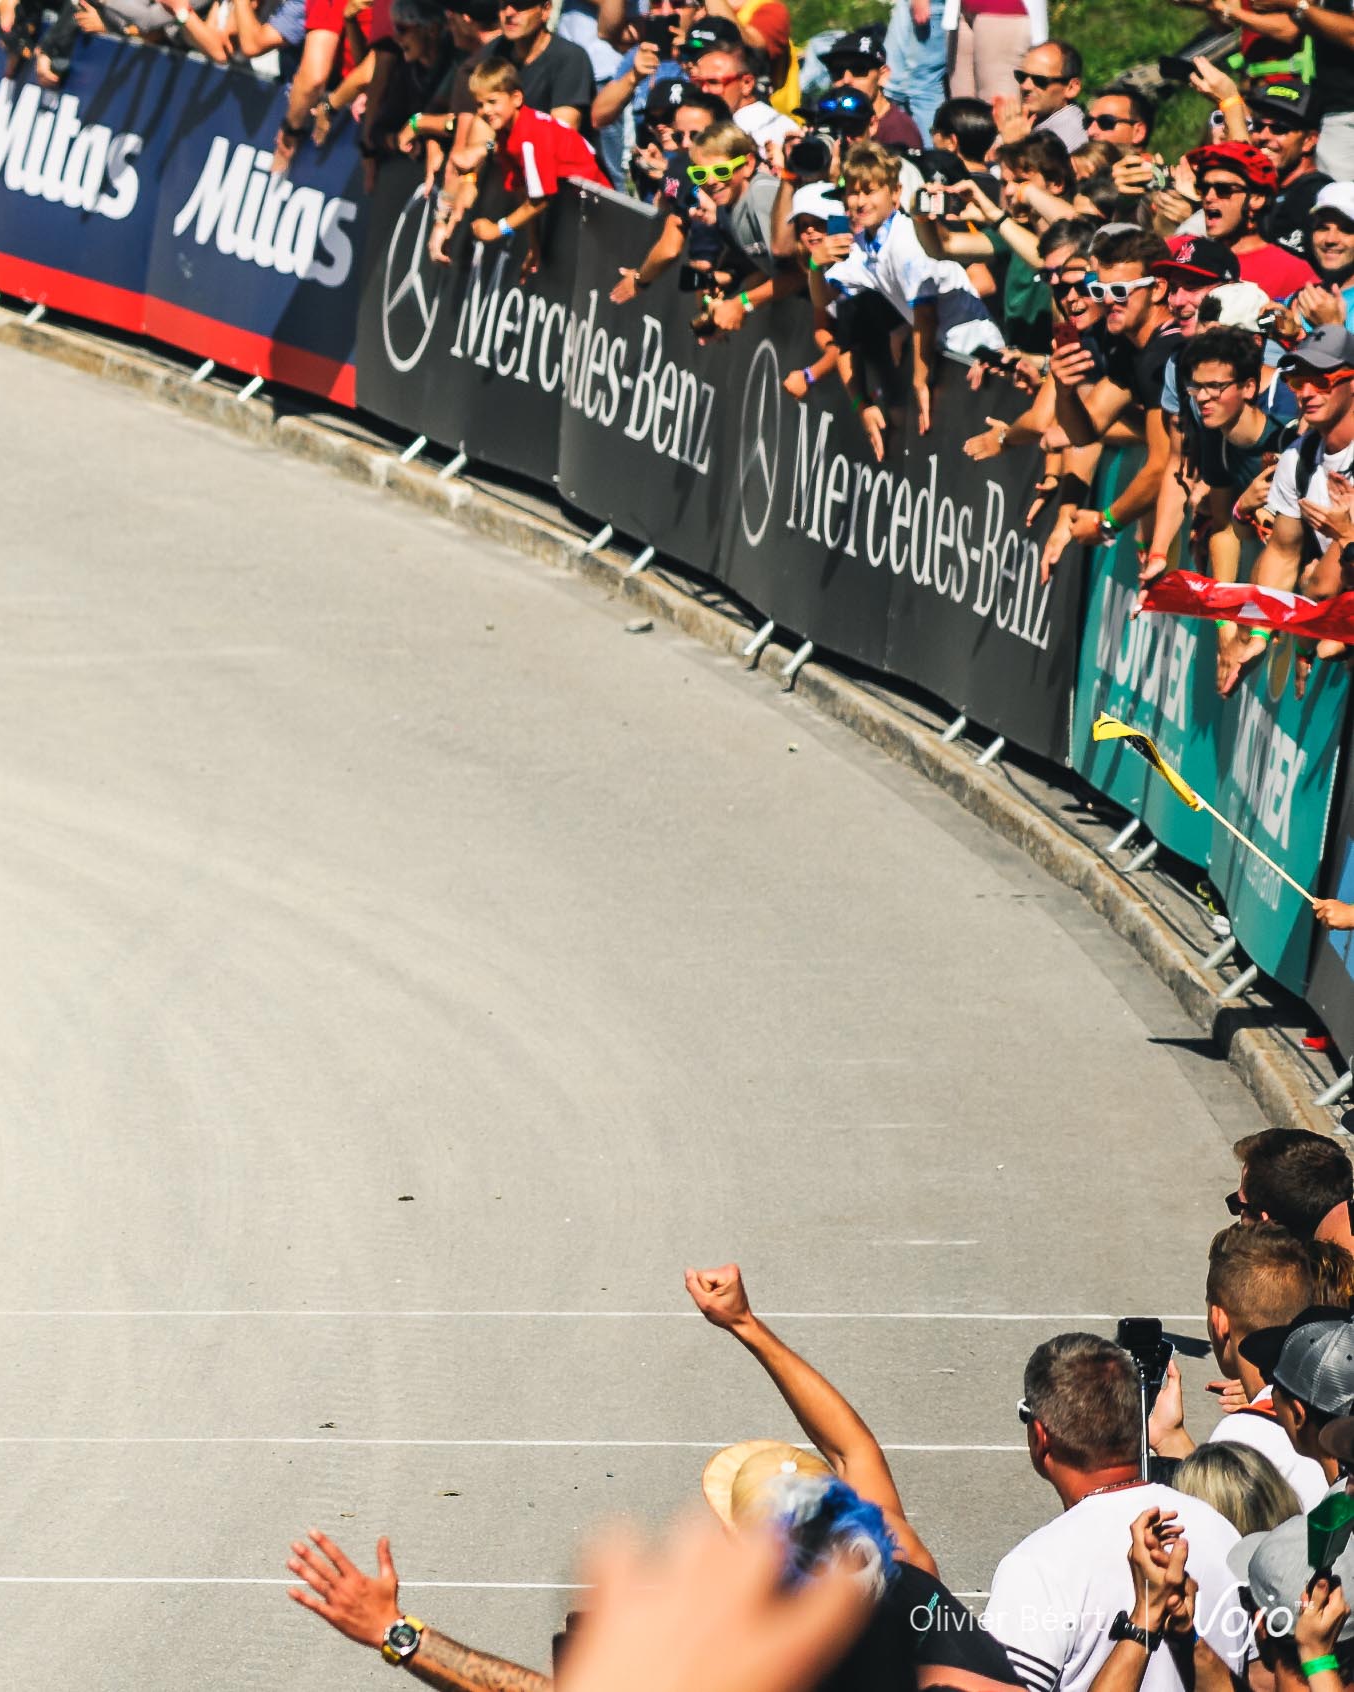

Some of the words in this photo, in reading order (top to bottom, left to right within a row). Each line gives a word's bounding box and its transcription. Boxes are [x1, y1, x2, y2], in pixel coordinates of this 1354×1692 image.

[173, 136, 358, 289] Mitas
[450, 241, 716, 475] Mercedes-Benz
[786, 402, 1054, 651] Mercedes-Benz
[1096, 575, 1198, 732] MOTOREX
[1232, 682, 1307, 851] MOTOREX
